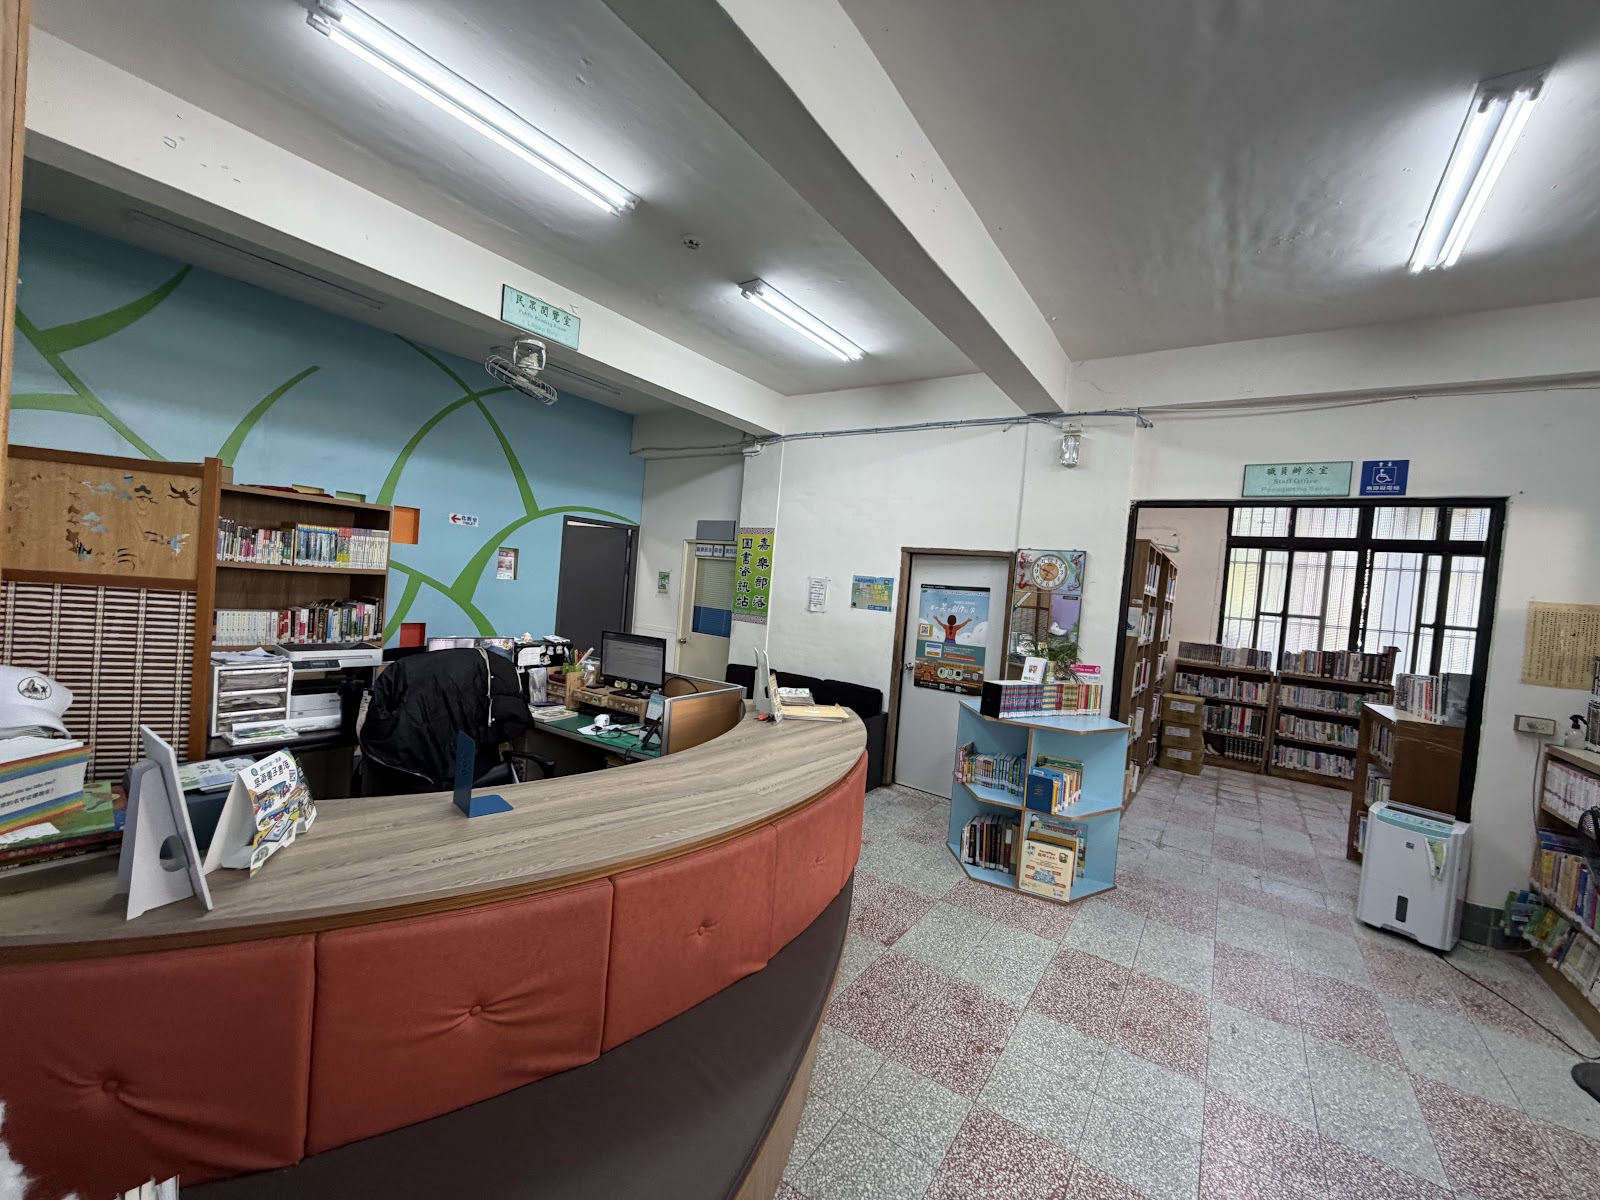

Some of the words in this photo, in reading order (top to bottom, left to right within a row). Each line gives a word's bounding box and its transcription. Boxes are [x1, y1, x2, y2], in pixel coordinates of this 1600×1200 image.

[518, 309, 533, 319] Public
[1266, 466, 1329, 477] 職員辦公室
[736, 538, 754, 608] 圖書資訊站
[752, 537, 771, 609] 嘉樂部落
